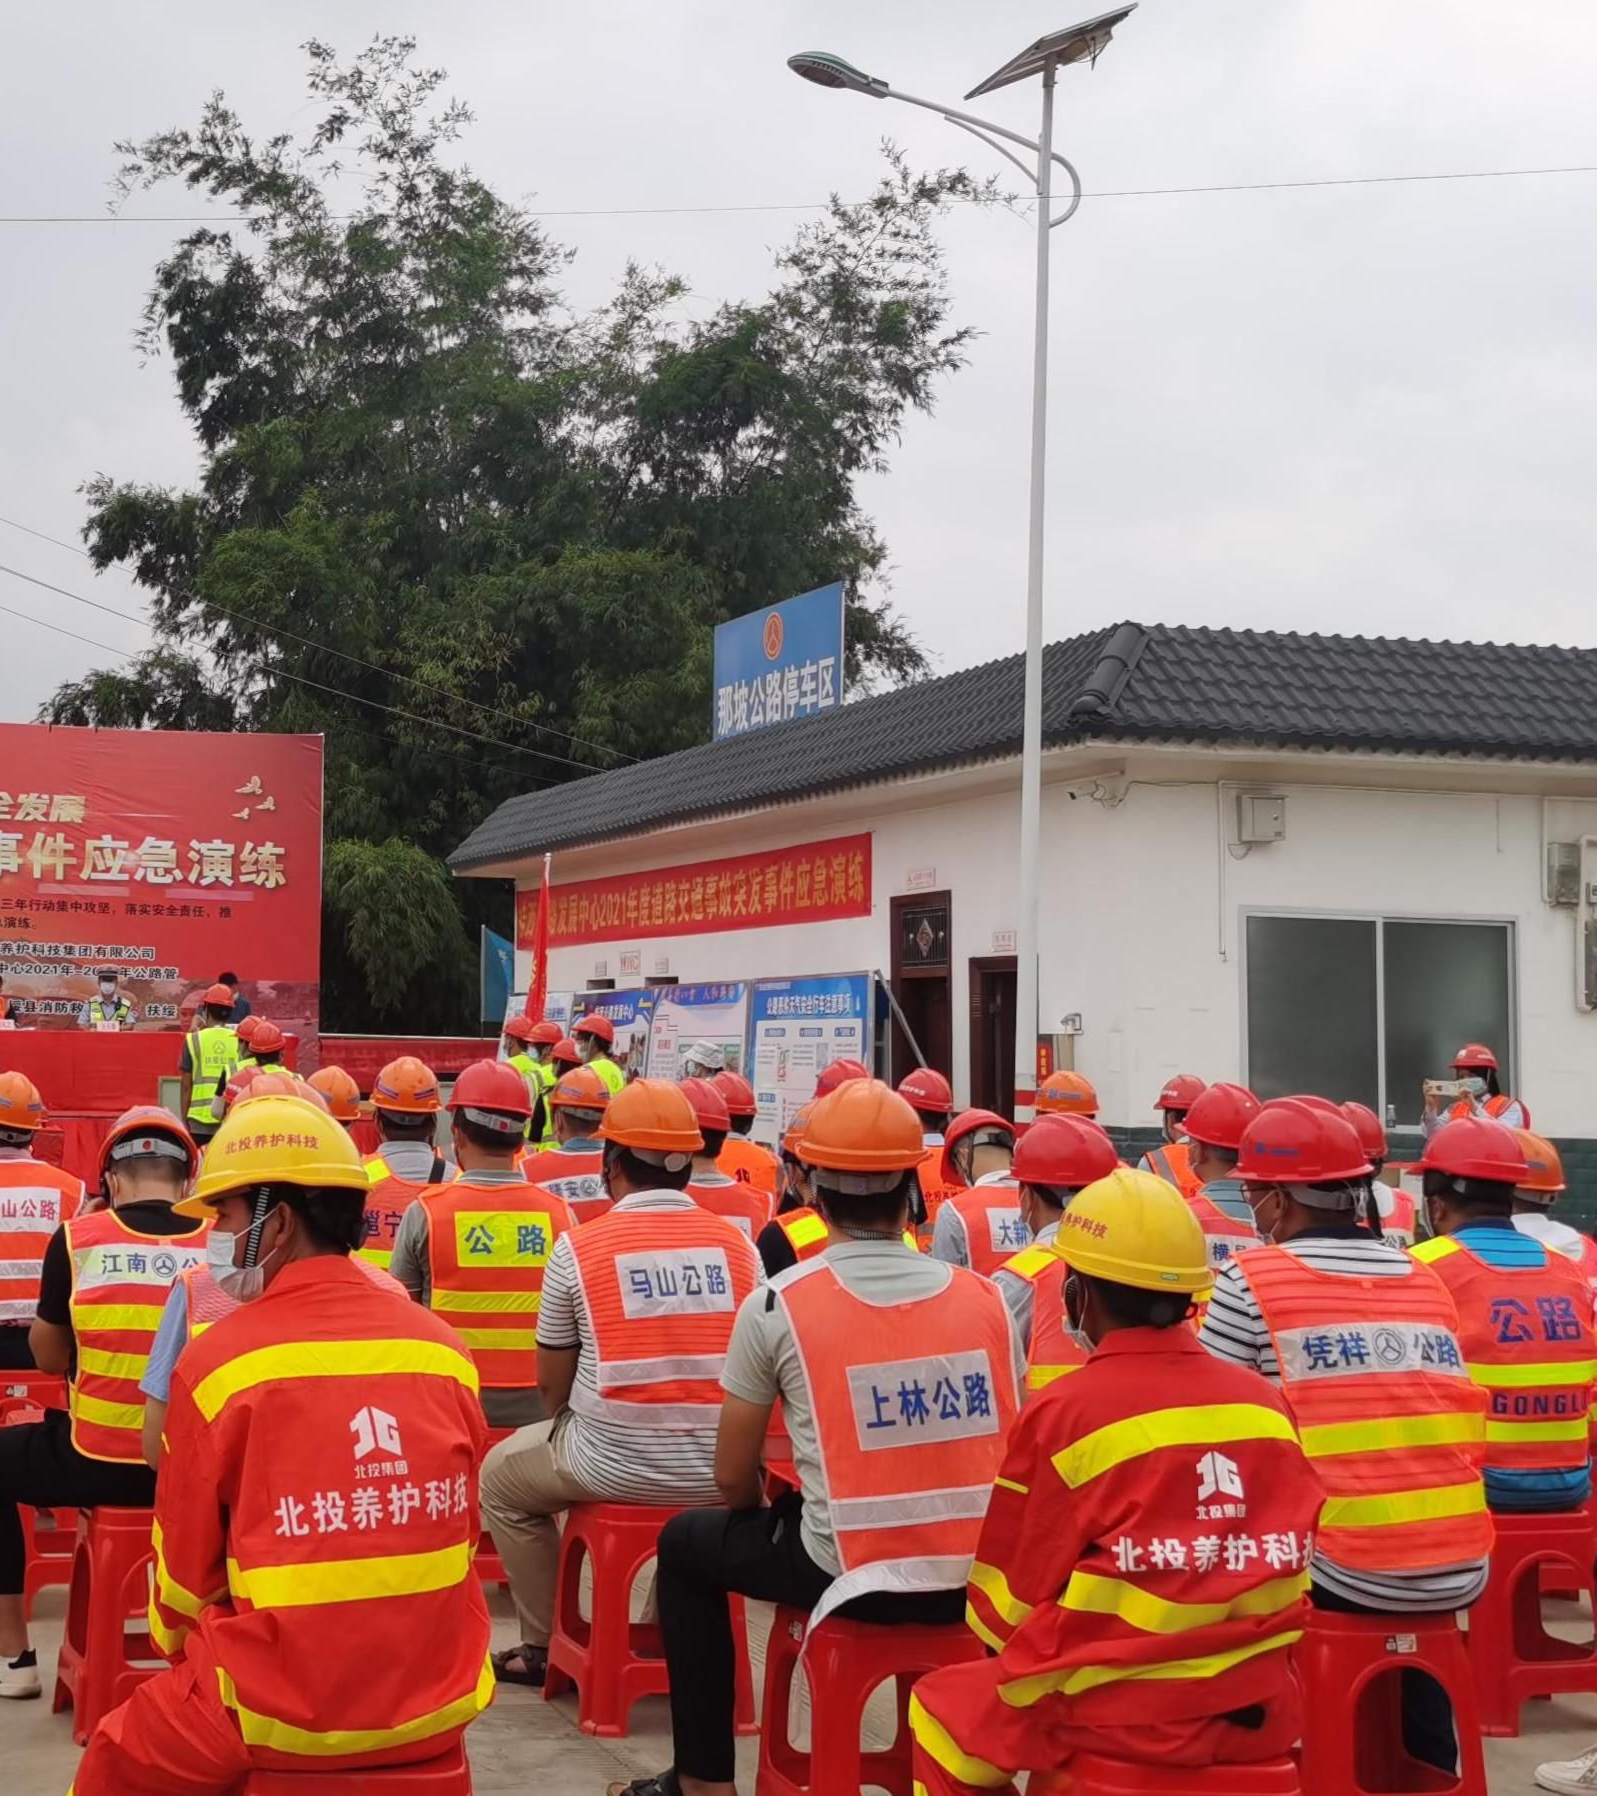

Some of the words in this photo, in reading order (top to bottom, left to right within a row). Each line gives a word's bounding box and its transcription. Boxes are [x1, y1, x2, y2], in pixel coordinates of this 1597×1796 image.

[717, 657, 835, 736] 那坡公路停车区
[225, 1133, 320, 1155] 北投养护科技
[465, 1224, 547, 1256] 公路
[101, 1252, 147, 1275] 江南
[629, 1265, 730, 1300] 马山公路
[1490, 1296, 1582, 1343] 公路
[1302, 1333, 1371, 1371] 凭祥
[1413, 1344, 1461, 1369] 公路
[865, 1372, 993, 1430] 上林公路
[354, 1460, 409, 1480] 北投集团
[274, 1471, 469, 1538] 北投养护科技
